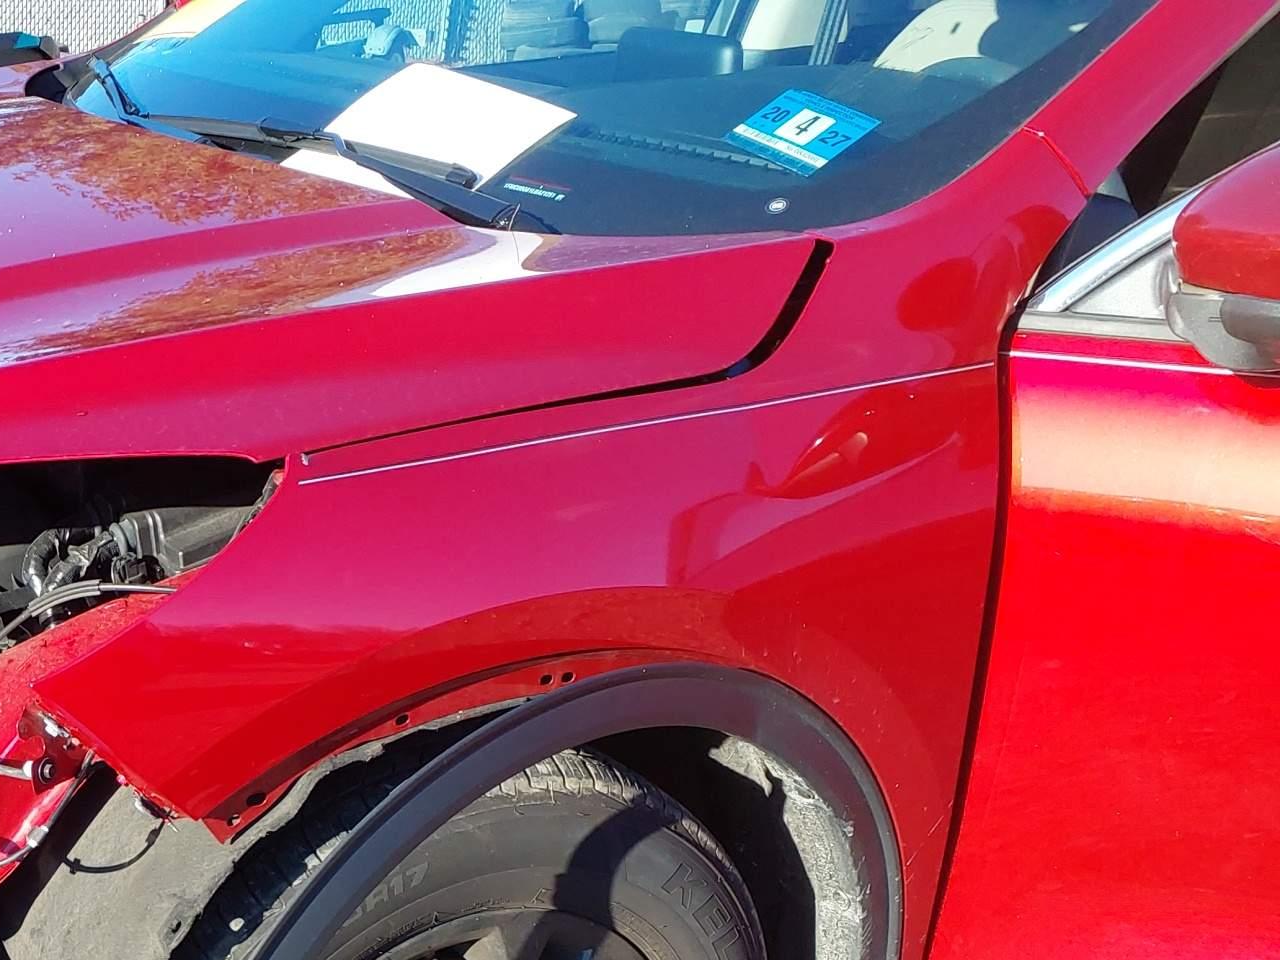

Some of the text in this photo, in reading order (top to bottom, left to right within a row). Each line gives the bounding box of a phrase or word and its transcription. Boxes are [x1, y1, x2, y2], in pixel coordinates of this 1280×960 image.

[761, 106, 791, 123] 20
[795, 115, 822, 136] 4
[820, 130, 851, 147] 27
